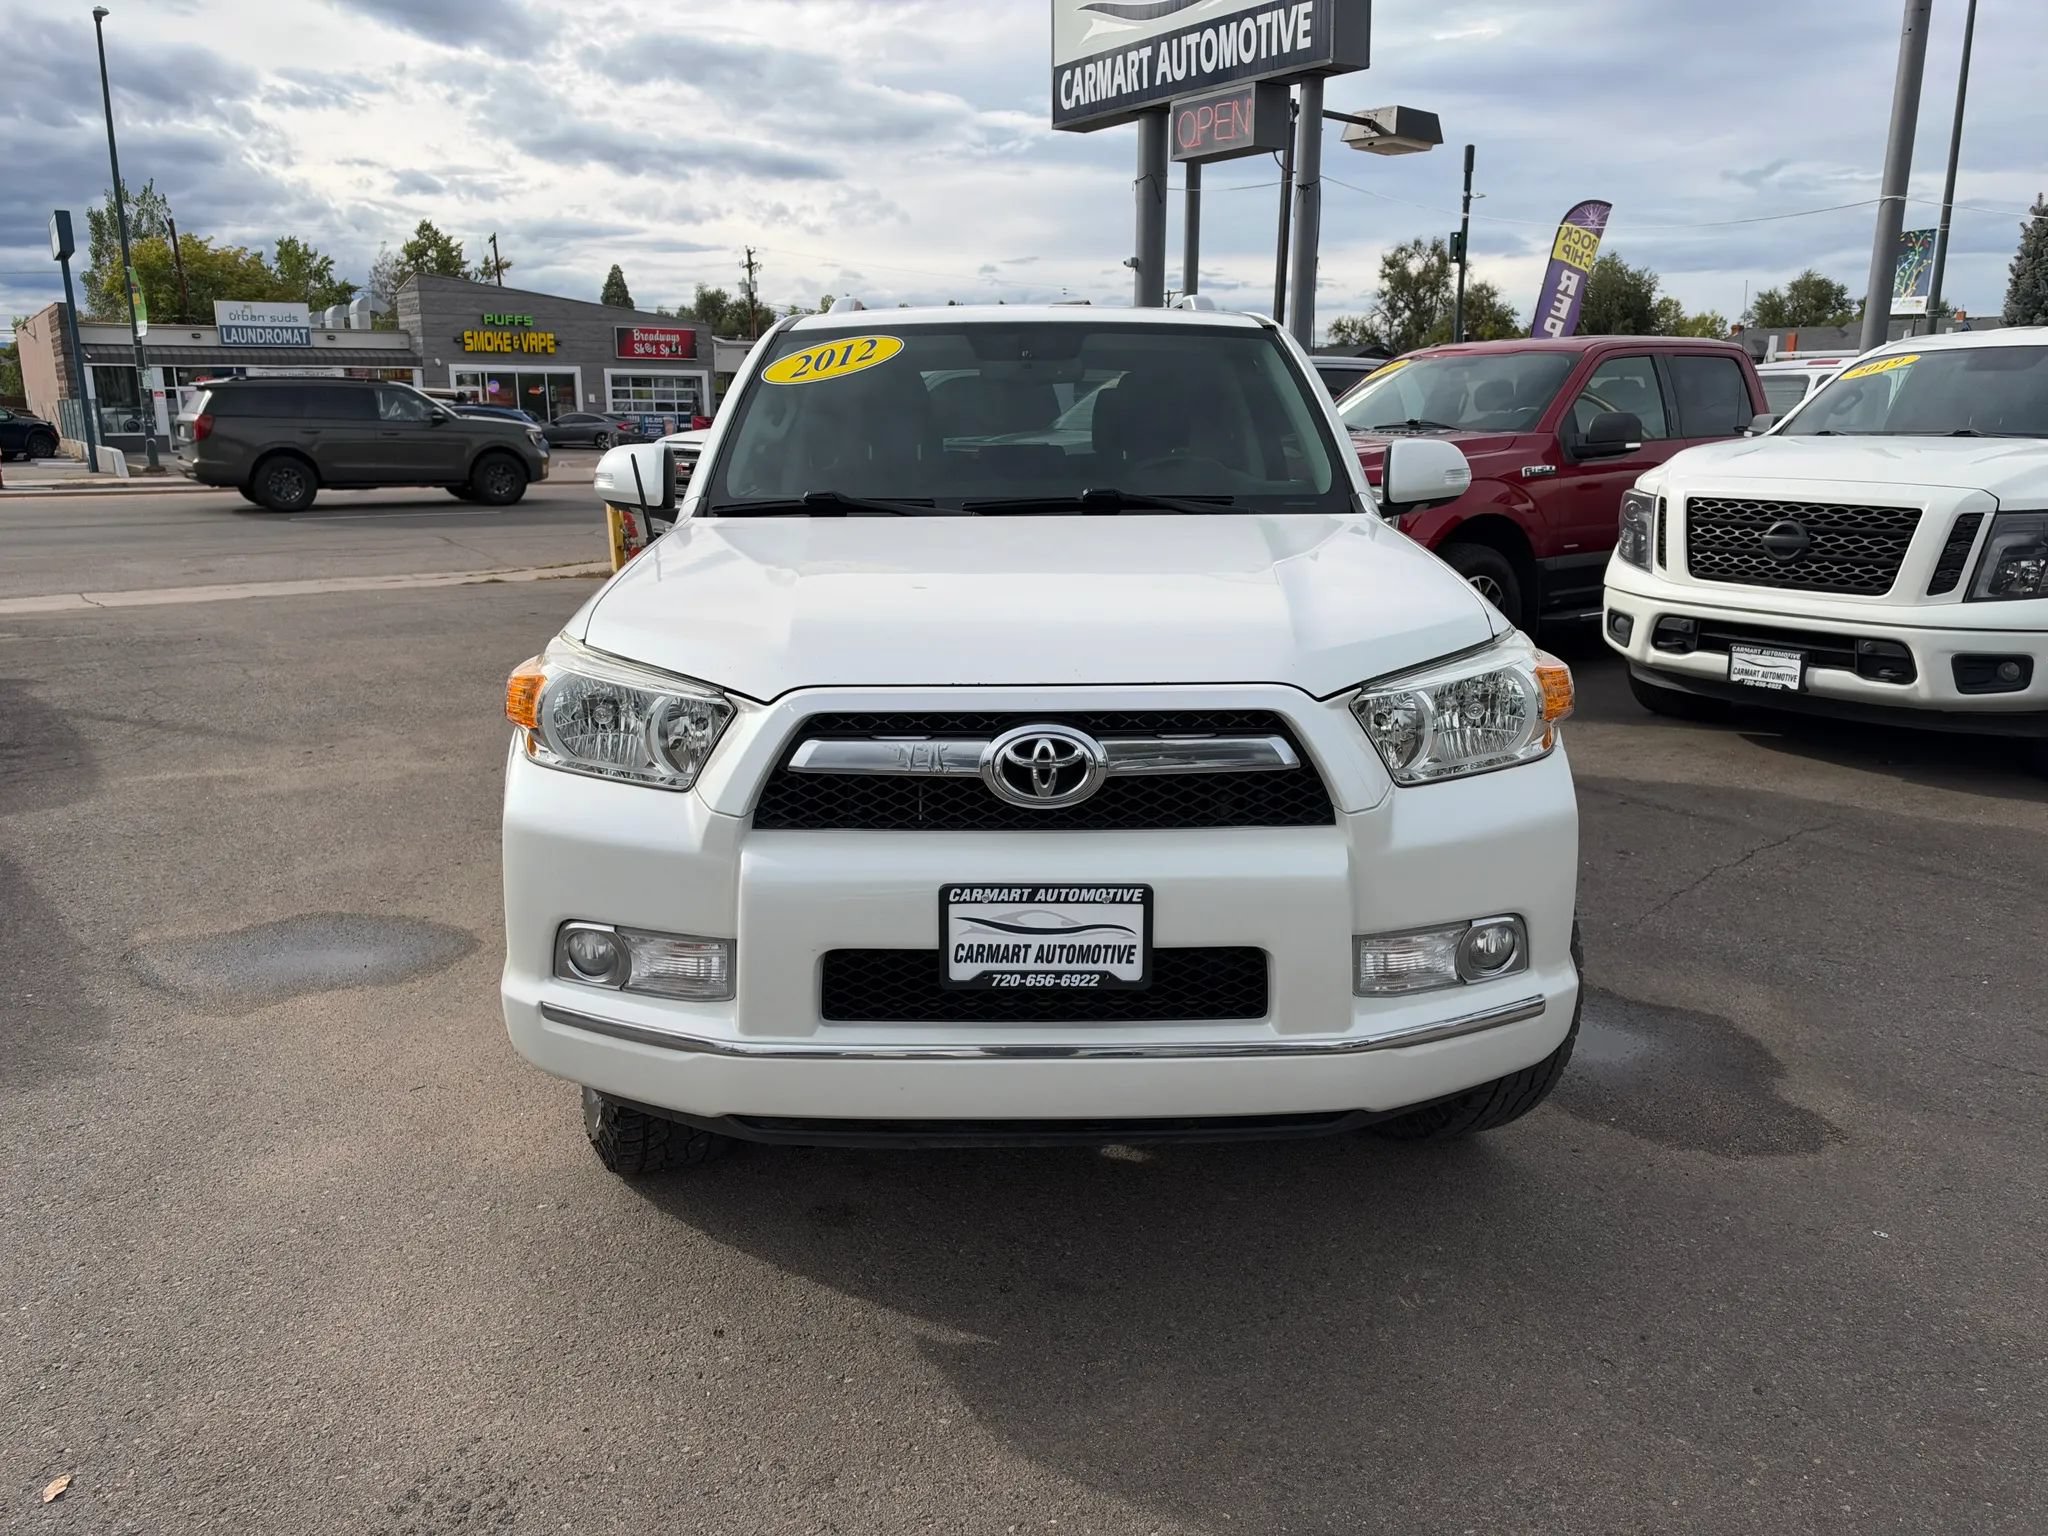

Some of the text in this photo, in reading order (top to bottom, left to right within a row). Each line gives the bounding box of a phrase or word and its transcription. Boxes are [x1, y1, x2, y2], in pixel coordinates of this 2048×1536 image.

[1060, 1, 1313, 110] CARMART AUTOMOTIVE
[1177, 97, 1253, 149] OPEN
[269, 312, 299, 323] suds
[483, 313, 534, 326] PUFFS
[222, 327, 308, 345] LAUNDROMAT
[463, 330, 556, 353] SMOKE & VAPE
[632, 329, 680, 344] Broadways
[789, 339, 878, 379] 2012
[1732, 646, 1801, 660] CARMART AUTOMOTIVE
[1733, 667, 1798, 683] CARMART AUTOMOTIVE
[949, 888, 1144, 902] CARMART AUTOMOTIVE
[954, 943, 1137, 965] CARMART AUTOMOTIVE
[990, 974, 1100, 987] 720-656-6922
